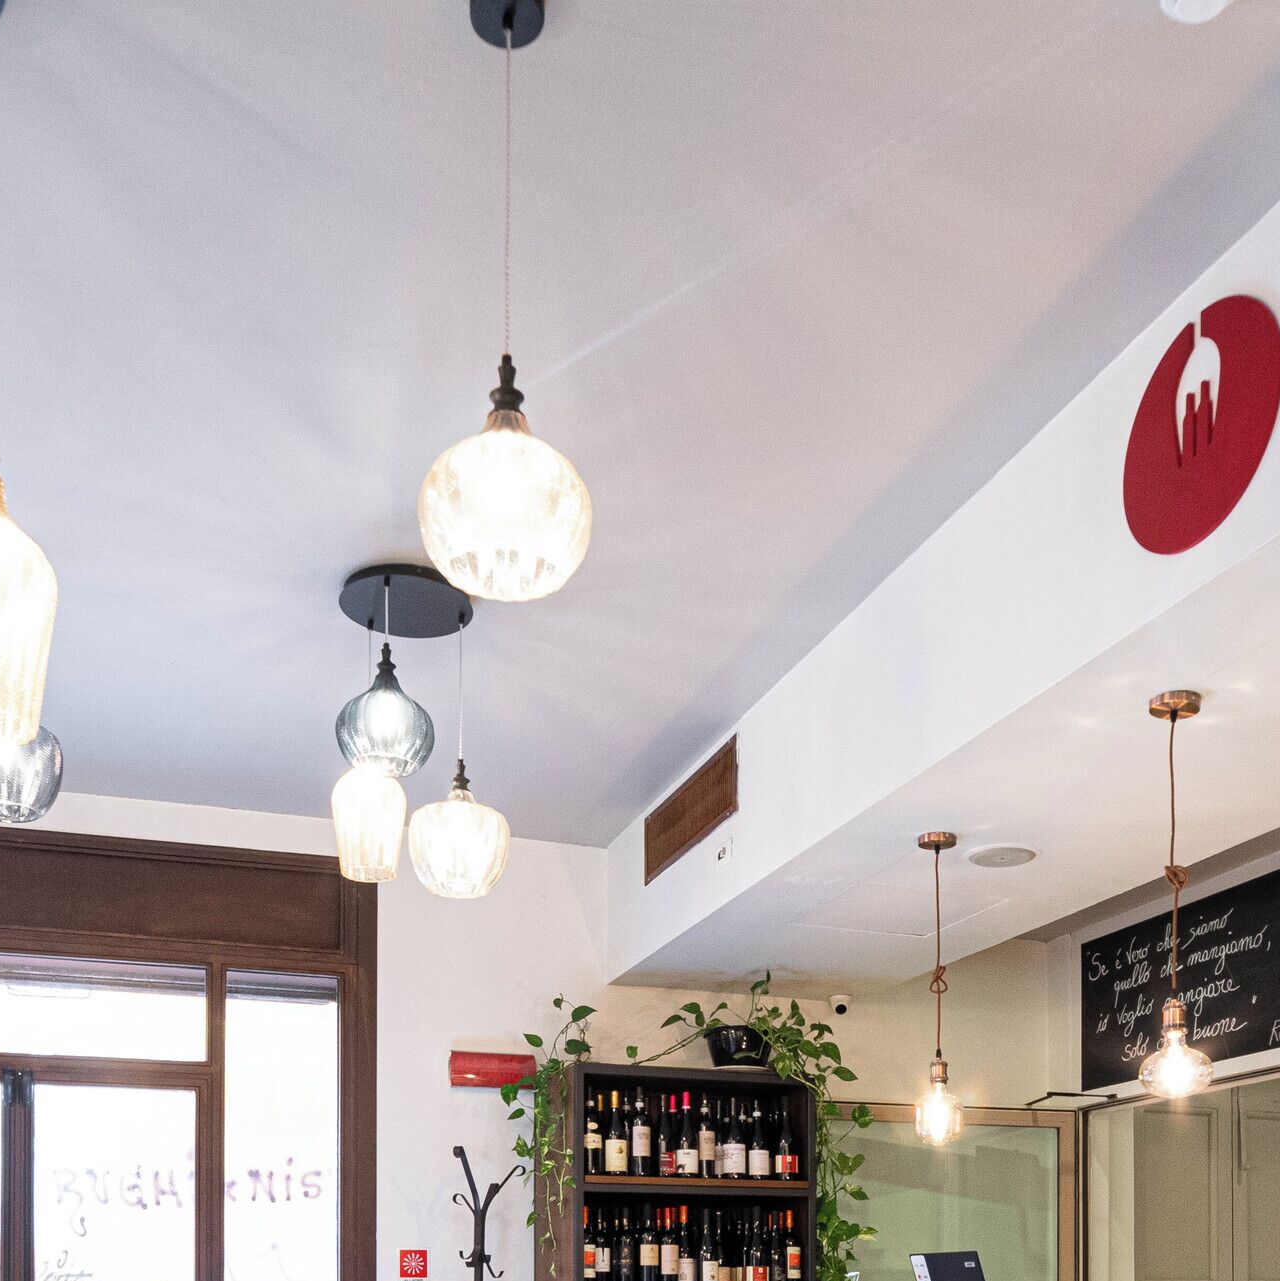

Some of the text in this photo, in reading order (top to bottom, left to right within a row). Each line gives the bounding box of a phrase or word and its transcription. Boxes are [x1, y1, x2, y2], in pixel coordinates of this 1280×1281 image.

[1181, 908, 1233, 950] siamo
[1114, 961, 1152, 1009] quello
[1096, 1013, 1110, 1034] io
[1192, 1014, 1248, 1041] buone
